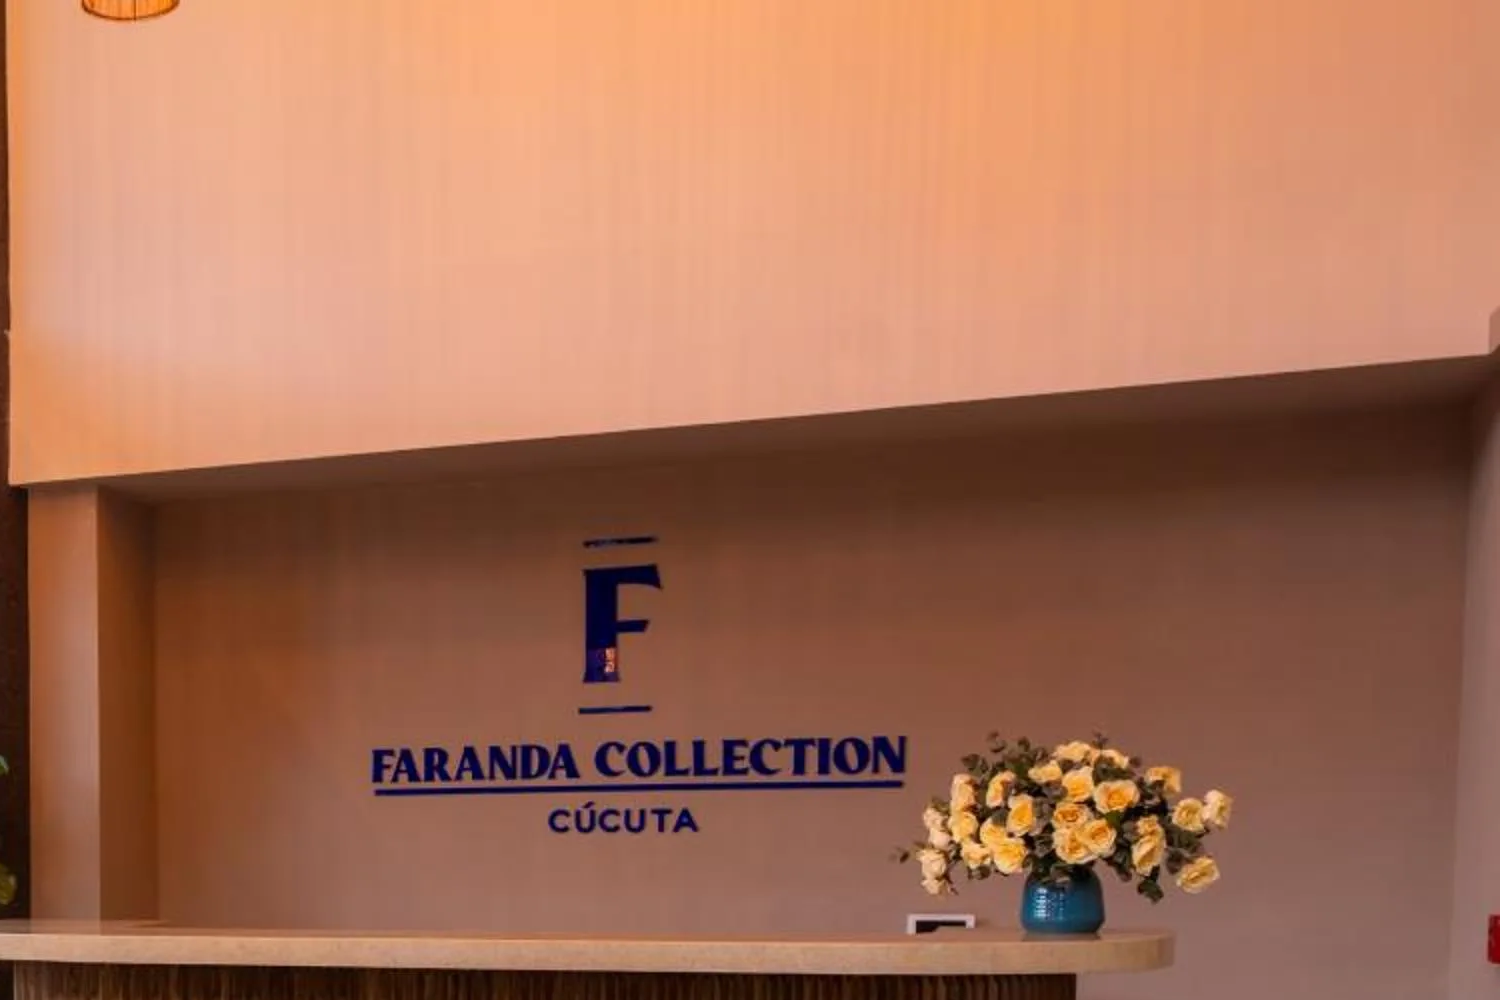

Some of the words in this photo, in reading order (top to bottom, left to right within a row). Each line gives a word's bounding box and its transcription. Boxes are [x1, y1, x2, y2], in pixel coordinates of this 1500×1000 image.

[582, 563, 663, 684] F
[371, 741, 581, 784] FARANDA
[593, 735, 907, 778] COLLECTION
[547, 801, 699, 834] CÚCUTA
